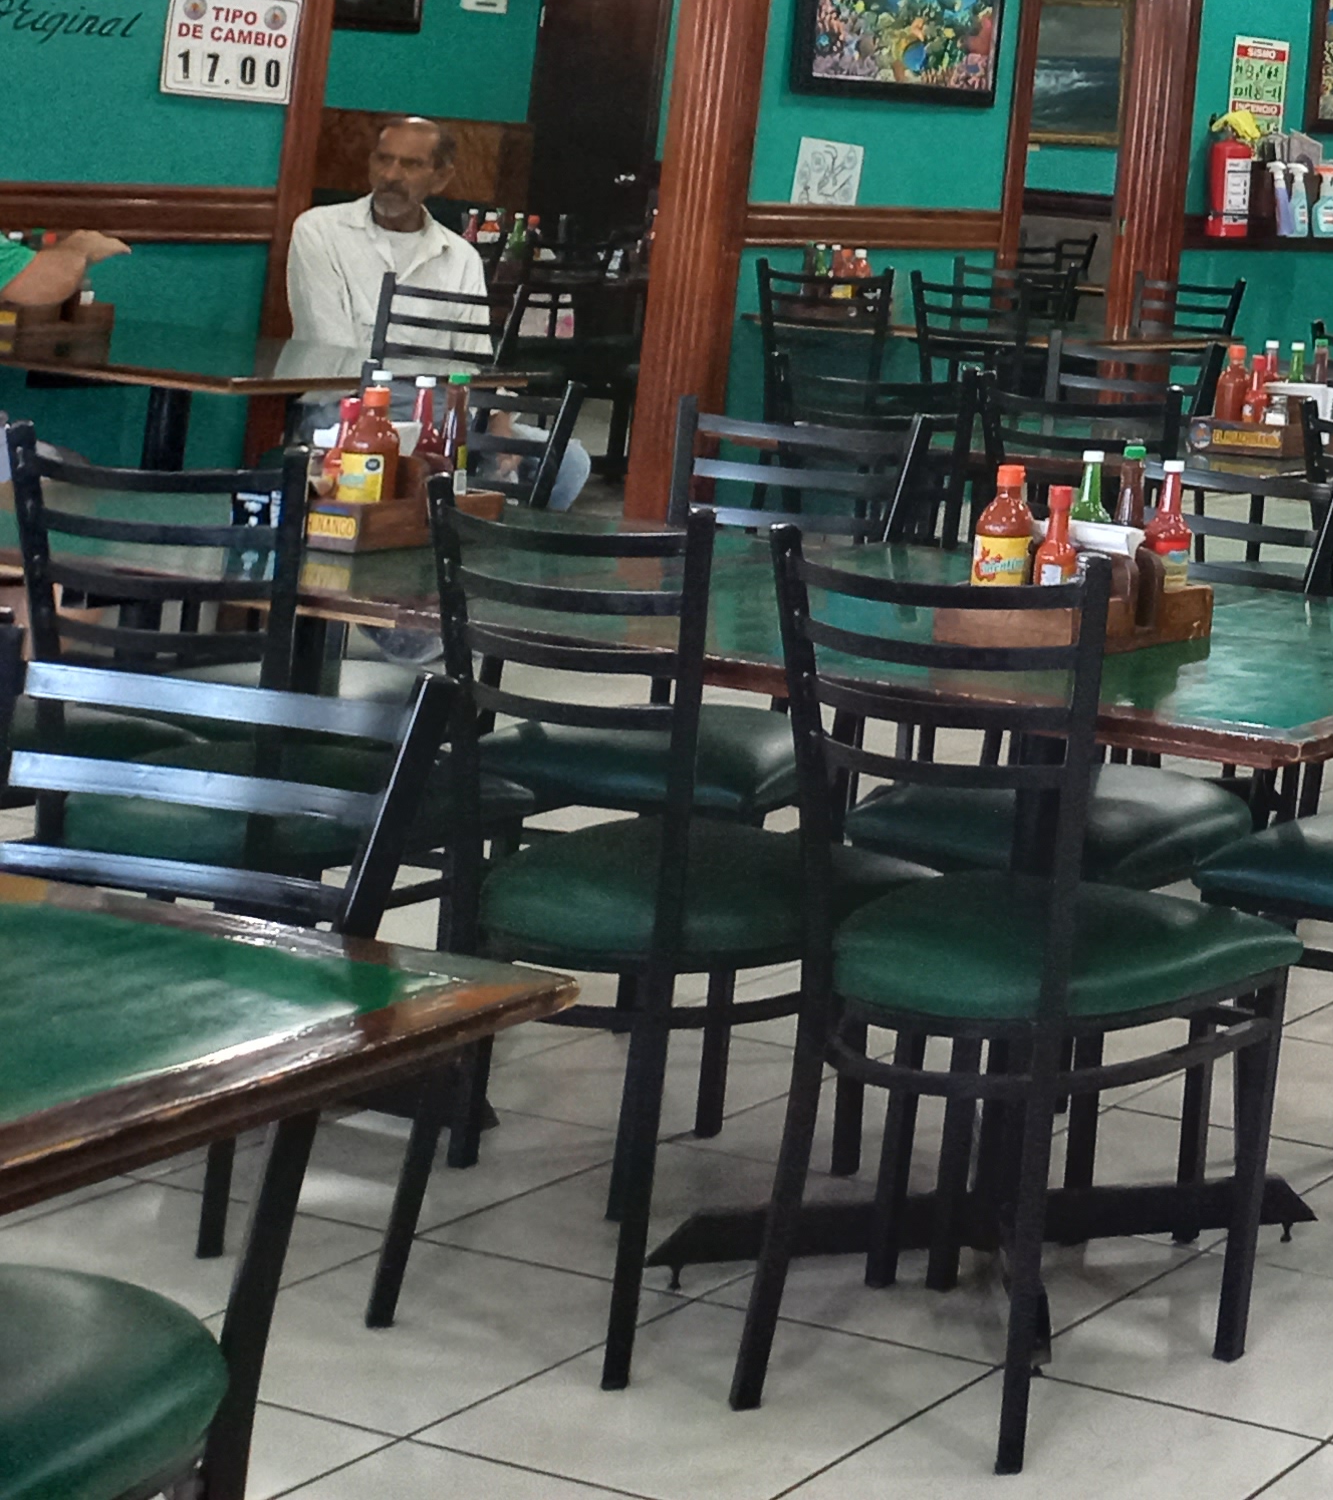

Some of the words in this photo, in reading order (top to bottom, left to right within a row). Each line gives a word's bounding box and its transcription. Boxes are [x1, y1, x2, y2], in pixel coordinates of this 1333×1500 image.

[212, 6, 258, 25] TIPO
[177, 23, 203, 39] DE
[210, 26, 288, 49] CAMBIO
[177, 49, 281, 88] 17.00
